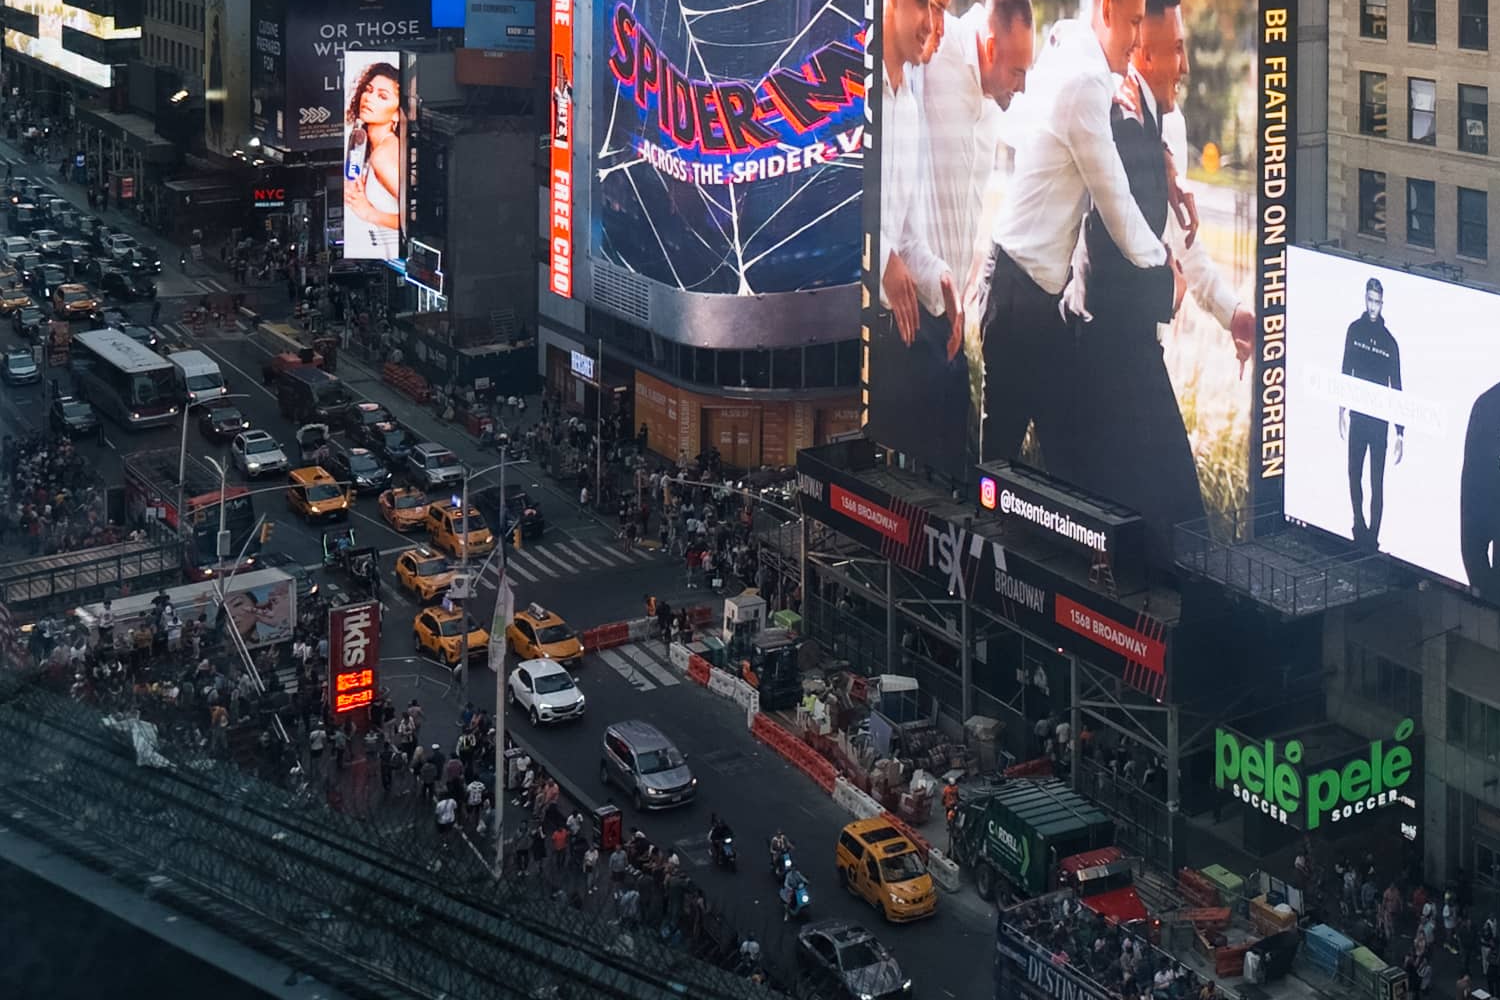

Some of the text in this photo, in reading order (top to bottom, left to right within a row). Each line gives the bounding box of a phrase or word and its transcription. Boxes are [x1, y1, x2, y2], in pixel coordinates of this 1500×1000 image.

[320, 20, 419, 38] OR THOSE
[642, 140, 687, 182] ACROSS
[691, 163, 723, 184] THE
[253, 188, 286, 200] NYC
[553, 168, 569, 297] FREE CHO
[1261, 8, 1288, 478] BE FEATURED ON THE BIG SCREEN
[858, 504, 898, 533] BROADWAY
[1000, 489, 1106, 551] @tsxentertainment
[924, 522, 966, 600] TSX
[993, 569, 1045, 614] BROADWAY
[1070, 608, 1148, 657] 1568 BROADWAY
[1233, 784, 1288, 825] SOCCER
[1027, 954, 1097, 1000] DESTINA
